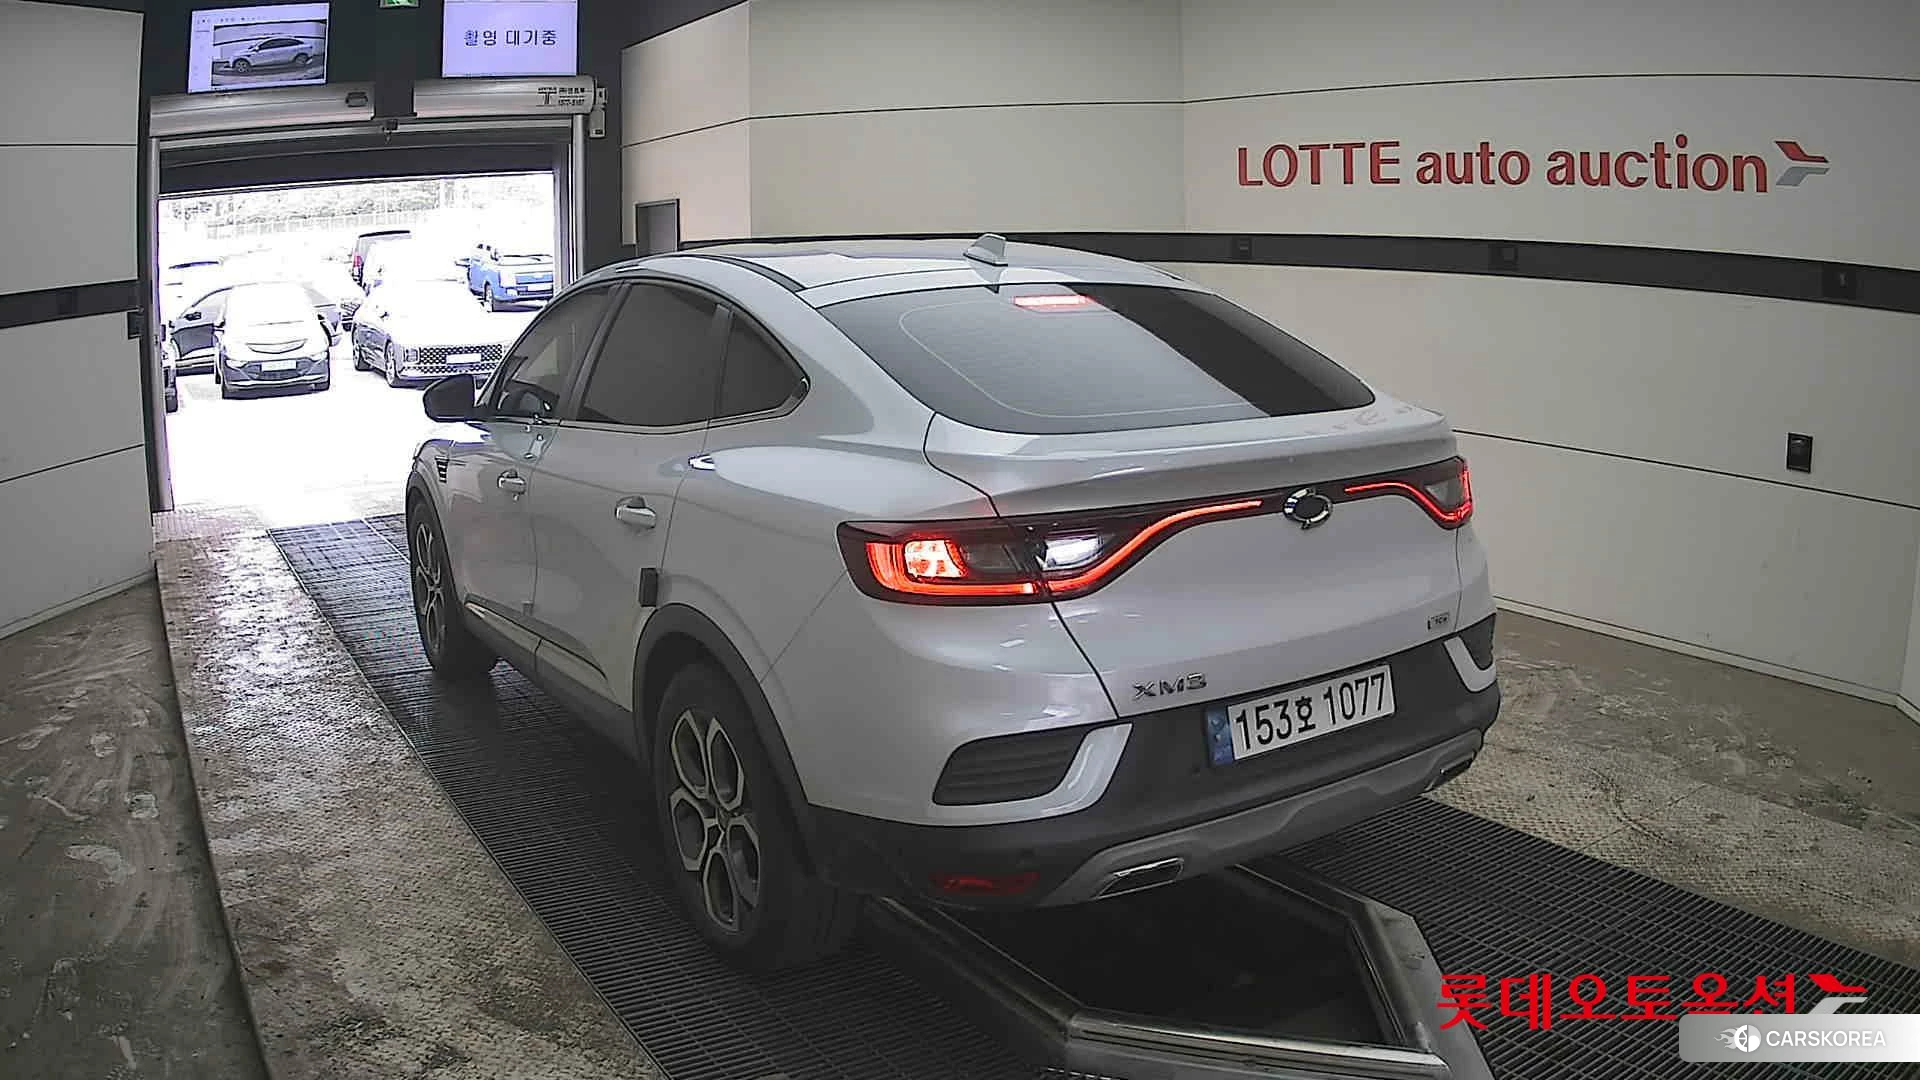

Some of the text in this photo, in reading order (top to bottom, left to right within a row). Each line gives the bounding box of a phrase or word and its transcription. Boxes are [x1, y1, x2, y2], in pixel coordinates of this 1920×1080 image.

[505, 30, 557, 46] 대기중
[1237, 135, 1768, 192] LOTTE auto auction
[1132, 672, 1207, 700] XM3
[1235, 673, 1387, 751] 153호 1077
